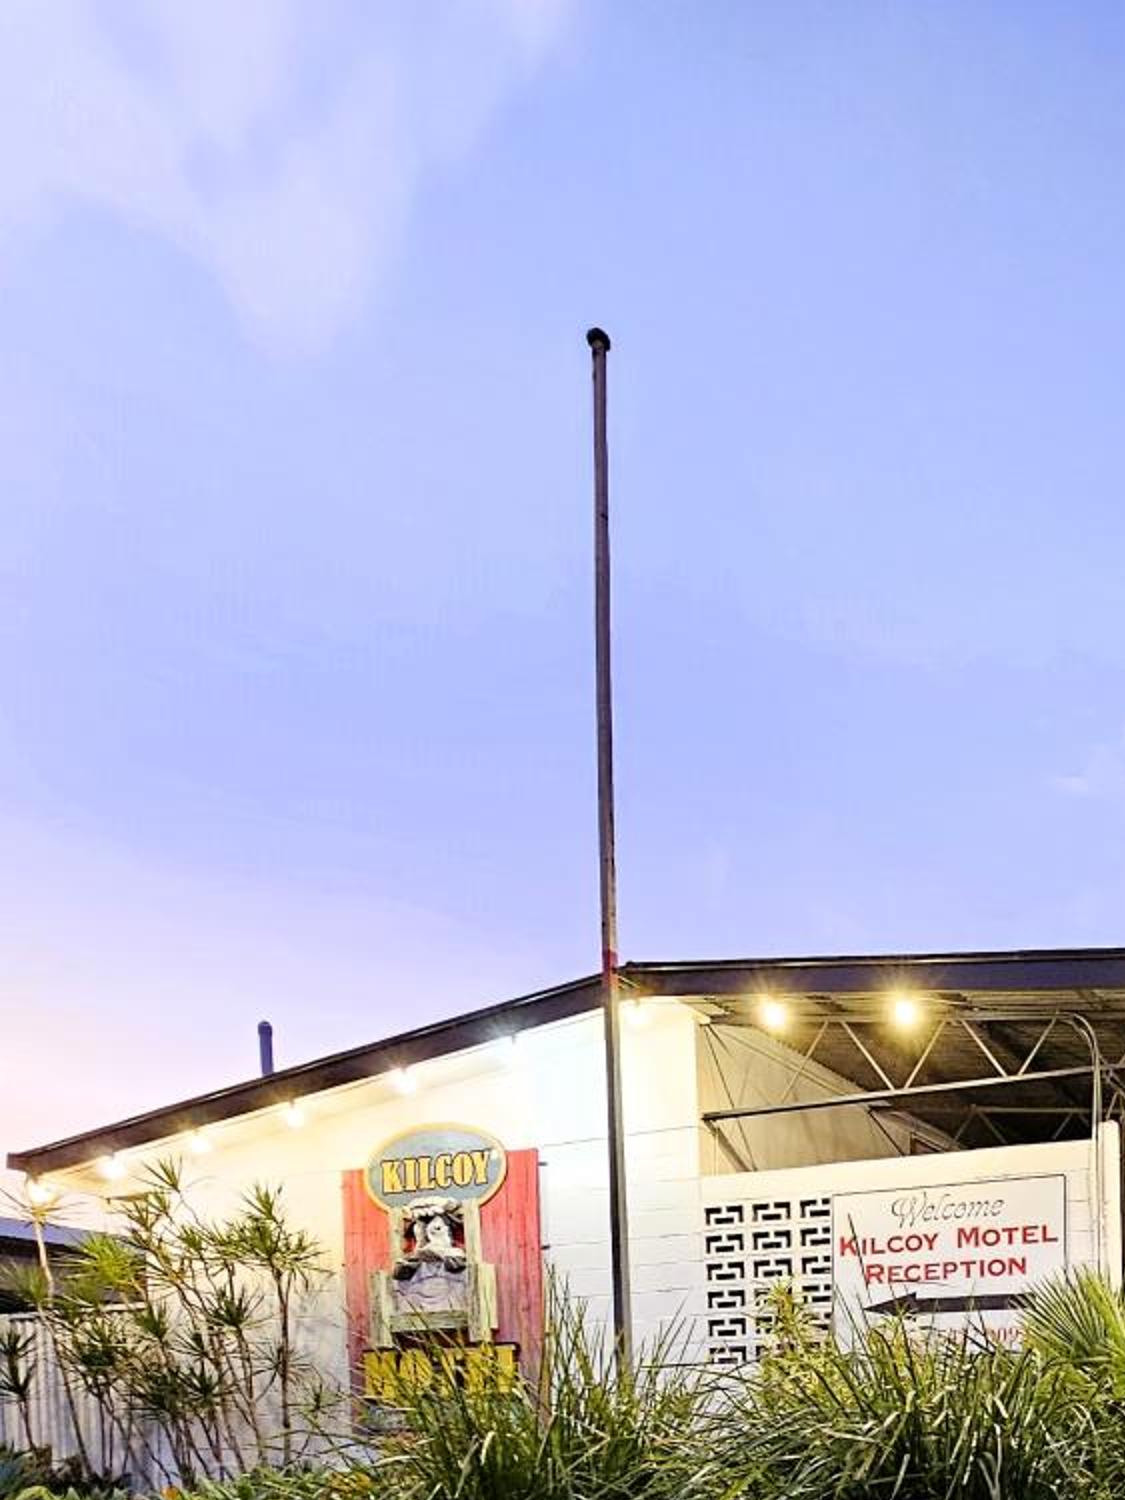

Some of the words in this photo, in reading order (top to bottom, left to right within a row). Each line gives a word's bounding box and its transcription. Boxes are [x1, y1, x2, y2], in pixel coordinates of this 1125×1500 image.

[381, 1148, 491, 1195] KILCOY
[891, 1191, 1006, 1229] Welcome
[839, 1232, 939, 1257] KILCOY
[957, 1224, 1059, 1249] MOTEL
[866, 1257, 1027, 1285] RECEPTION
